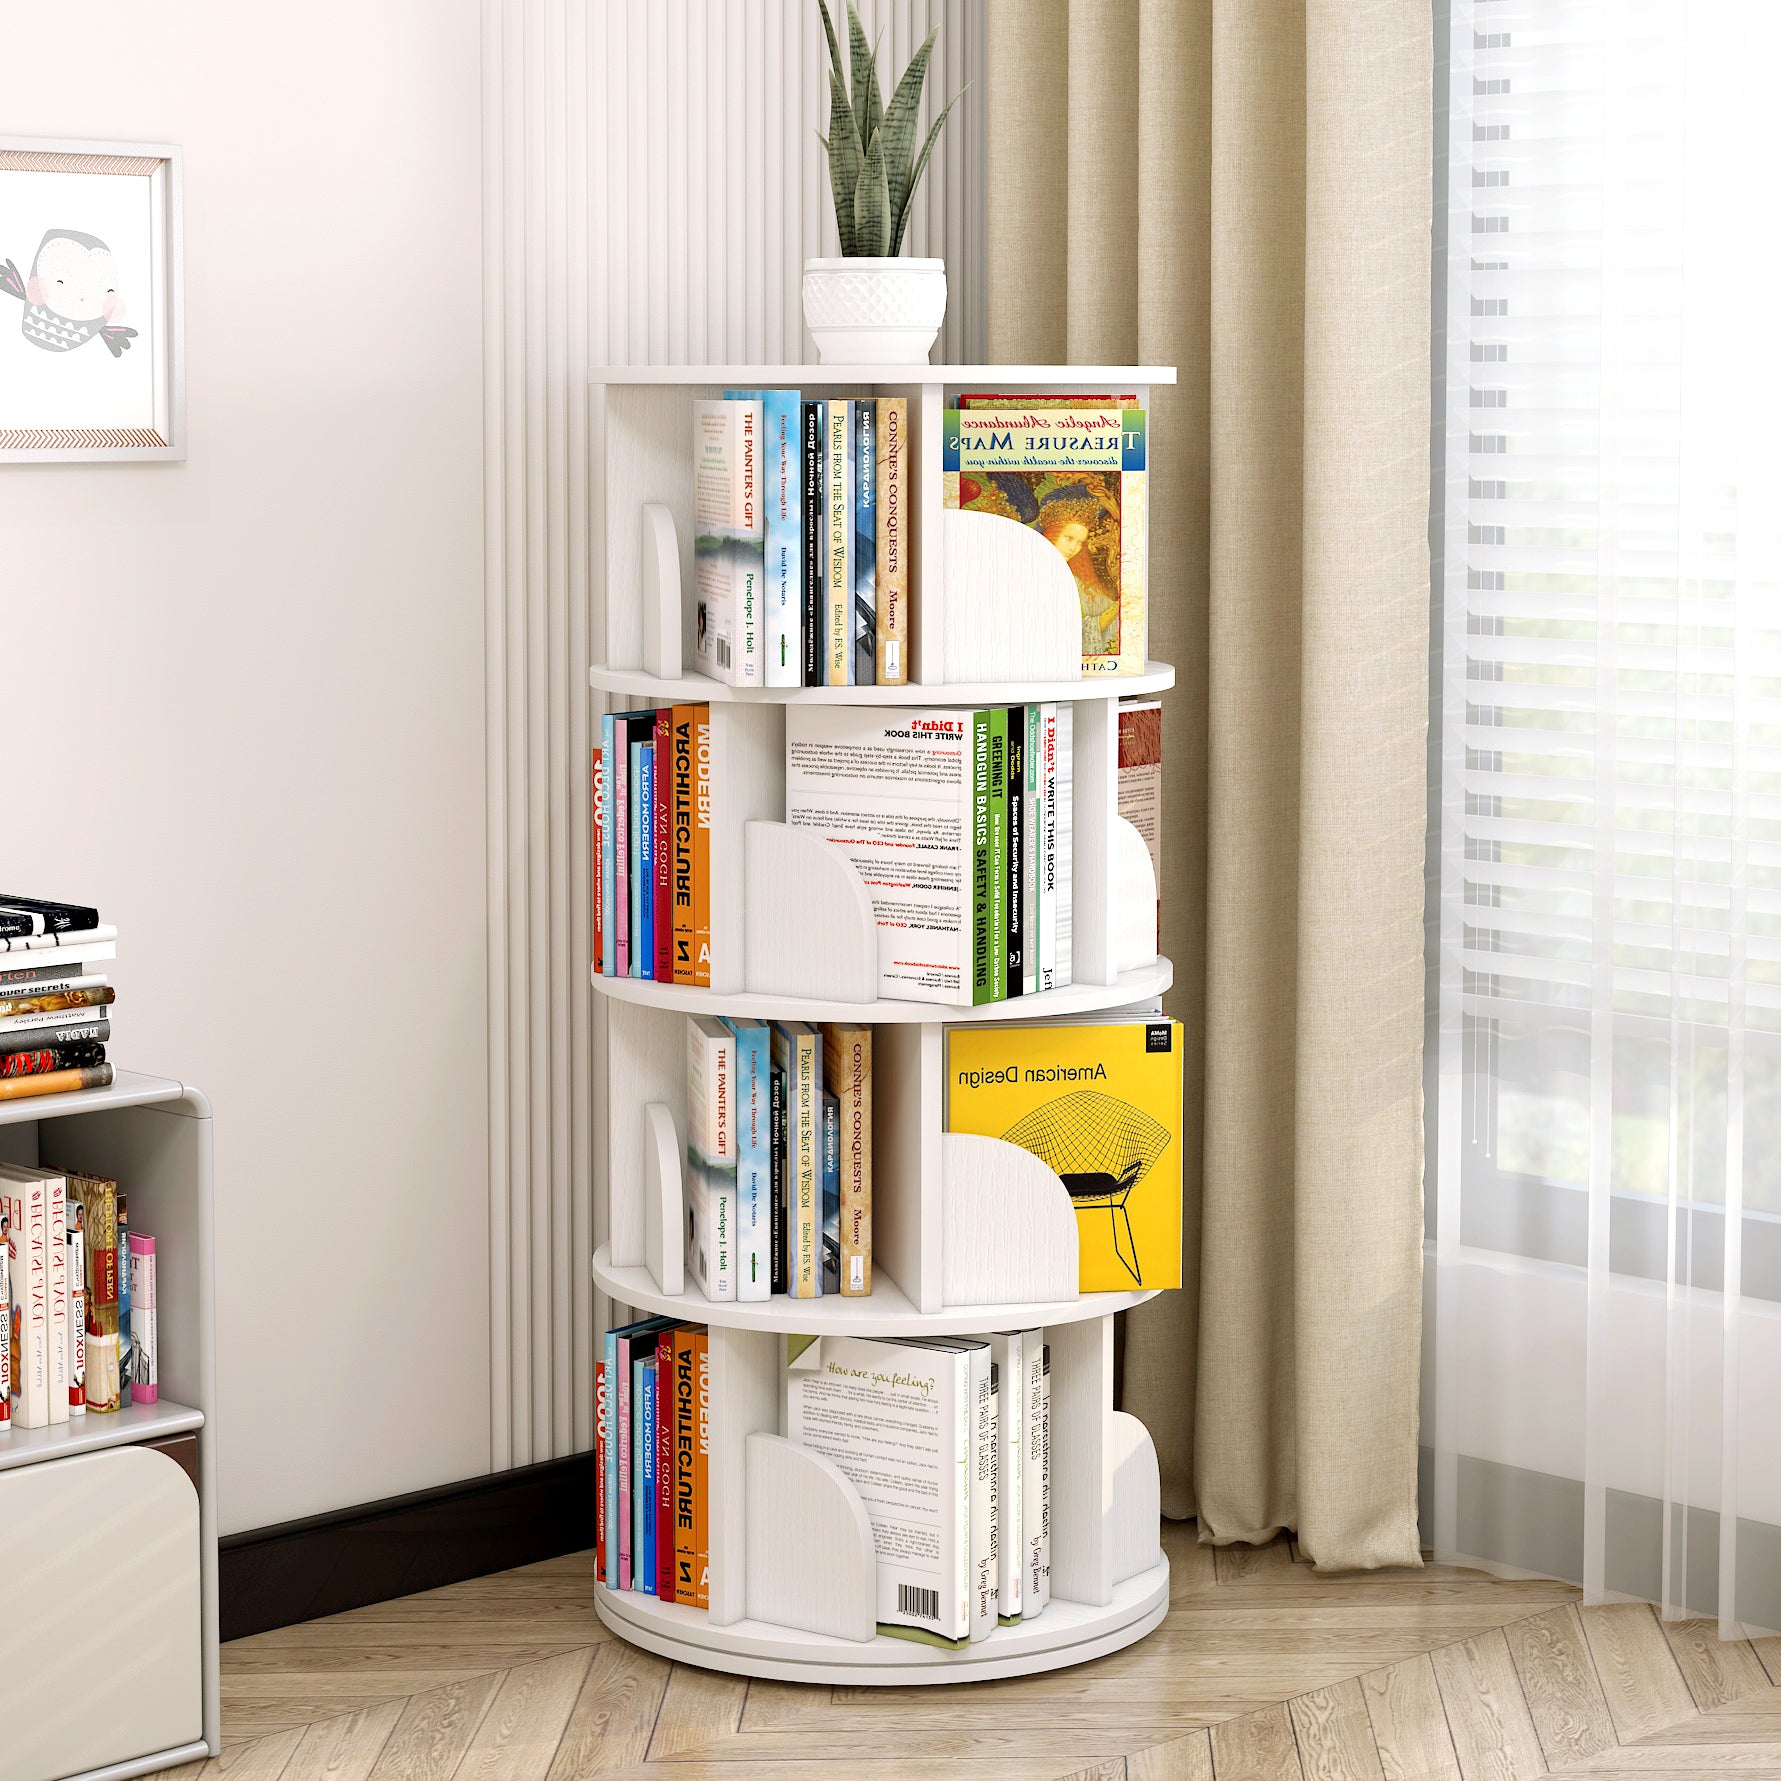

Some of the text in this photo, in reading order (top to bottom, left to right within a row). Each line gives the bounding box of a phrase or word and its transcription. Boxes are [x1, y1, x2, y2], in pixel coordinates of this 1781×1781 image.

[833, 415, 844, 588] PEARLS FROM THE SEAT OF WISDOM
[887, 411, 898, 573] CONNIE'S CONQUESTS
[744, 573, 754, 619] Penelope
[782, 570, 786, 578] De
[977, 723, 987, 845] HANDGUN BASICS
[992, 735, 1002, 798] GREENING IT
[1013, 826, 1018, 835] of
[976, 849, 986, 987] SAFETY & HANDLING
[28, 982, 70, 994] secrets
[14, 1011, 86, 1025] Matthew Parsley
[718, 1048, 726, 1156] THE PAINTER'S GIFT
[802, 1048, 812, 1208] PEARLS FROM THE SEAT OF WISDOM
[852, 1043, 862, 1193] CONNIE'S CONQUESTS
[718, 1197, 727, 1239] Penelope
[853, 1209, 862, 1245] Moore
[720, 1250, 728, 1271] Holt
[826, 1362, 935, 1397] How are you feeling?
[979, 1376, 988, 1480] THREE PAIRS OF GLASSES
[1032, 1357, 1041, 1461] THREE PAIRS OF GLASSES
[978, 1558, 990, 1568] by
[978, 1569, 990, 1589] Greg
[1031, 1535, 1042, 1594] by Greg Bennet
